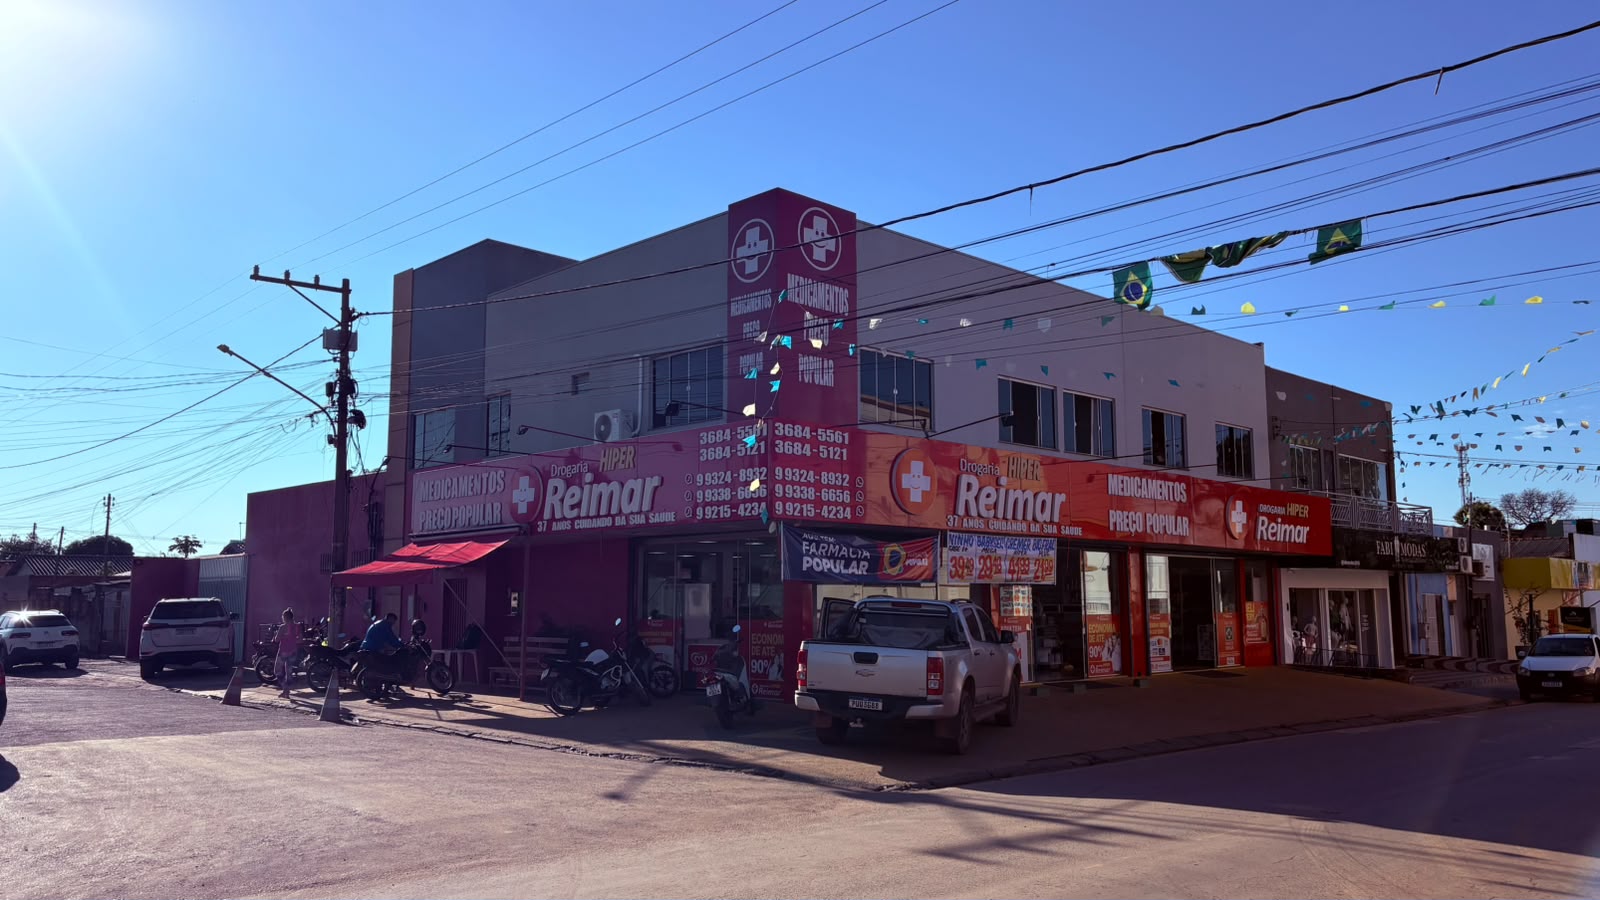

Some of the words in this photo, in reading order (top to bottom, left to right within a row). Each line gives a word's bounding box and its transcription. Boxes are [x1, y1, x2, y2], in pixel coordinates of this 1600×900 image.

[730, 288, 772, 317] MEDICAMENTOS
[787, 273, 849, 316] MEDICAMENTOS
[798, 353, 834, 387] POPULAR
[700, 423, 768, 444] 3684-5561
[775, 422, 849, 445] 3684-5561
[551, 461, 588, 478] Drogaria
[599, 445, 636, 472] HIPER
[700, 441, 766, 461] 3684-5121
[775, 440, 847, 461] 3684-5121
[960, 458, 1000, 477] Drogaria
[1007, 456, 1041, 481] HIPER
[420, 469, 505, 502] MEDICAMENTOS
[543, 473, 663, 520] Reimar
[955, 473, 1066, 523] Reimar
[1107, 473, 1188, 503] MEDICAMENTOS
[452, 502, 502, 529] POPULAR
[537, 520, 547, 533] 37
[552, 519, 572, 531] ANOS
[574, 516, 612, 530] CUIDANDO
[615, 516, 626, 527] DA
[629, 513, 646, 525] SUA
[1108, 509, 1143, 537] PREÇO
[1146, 512, 1190, 537] POPULAR
[1258, 503, 1286, 516] DROGARIA
[1286, 502, 1310, 518] HIPER
[946, 515, 958, 528] 37
[962, 518, 985, 529] ANOS
[988, 520, 1027, 533] CUIDANDO
[1030, 523, 1040, 533] DA
[1042, 523, 1057, 535] SUA
[1256, 515, 1310, 544] Reimar
[1376, 540, 1394, 556] FABI
[1400, 542, 1427, 558] MODAS
[802, 556, 869, 575] POPULAR
[751, 645, 761, 656] DE
